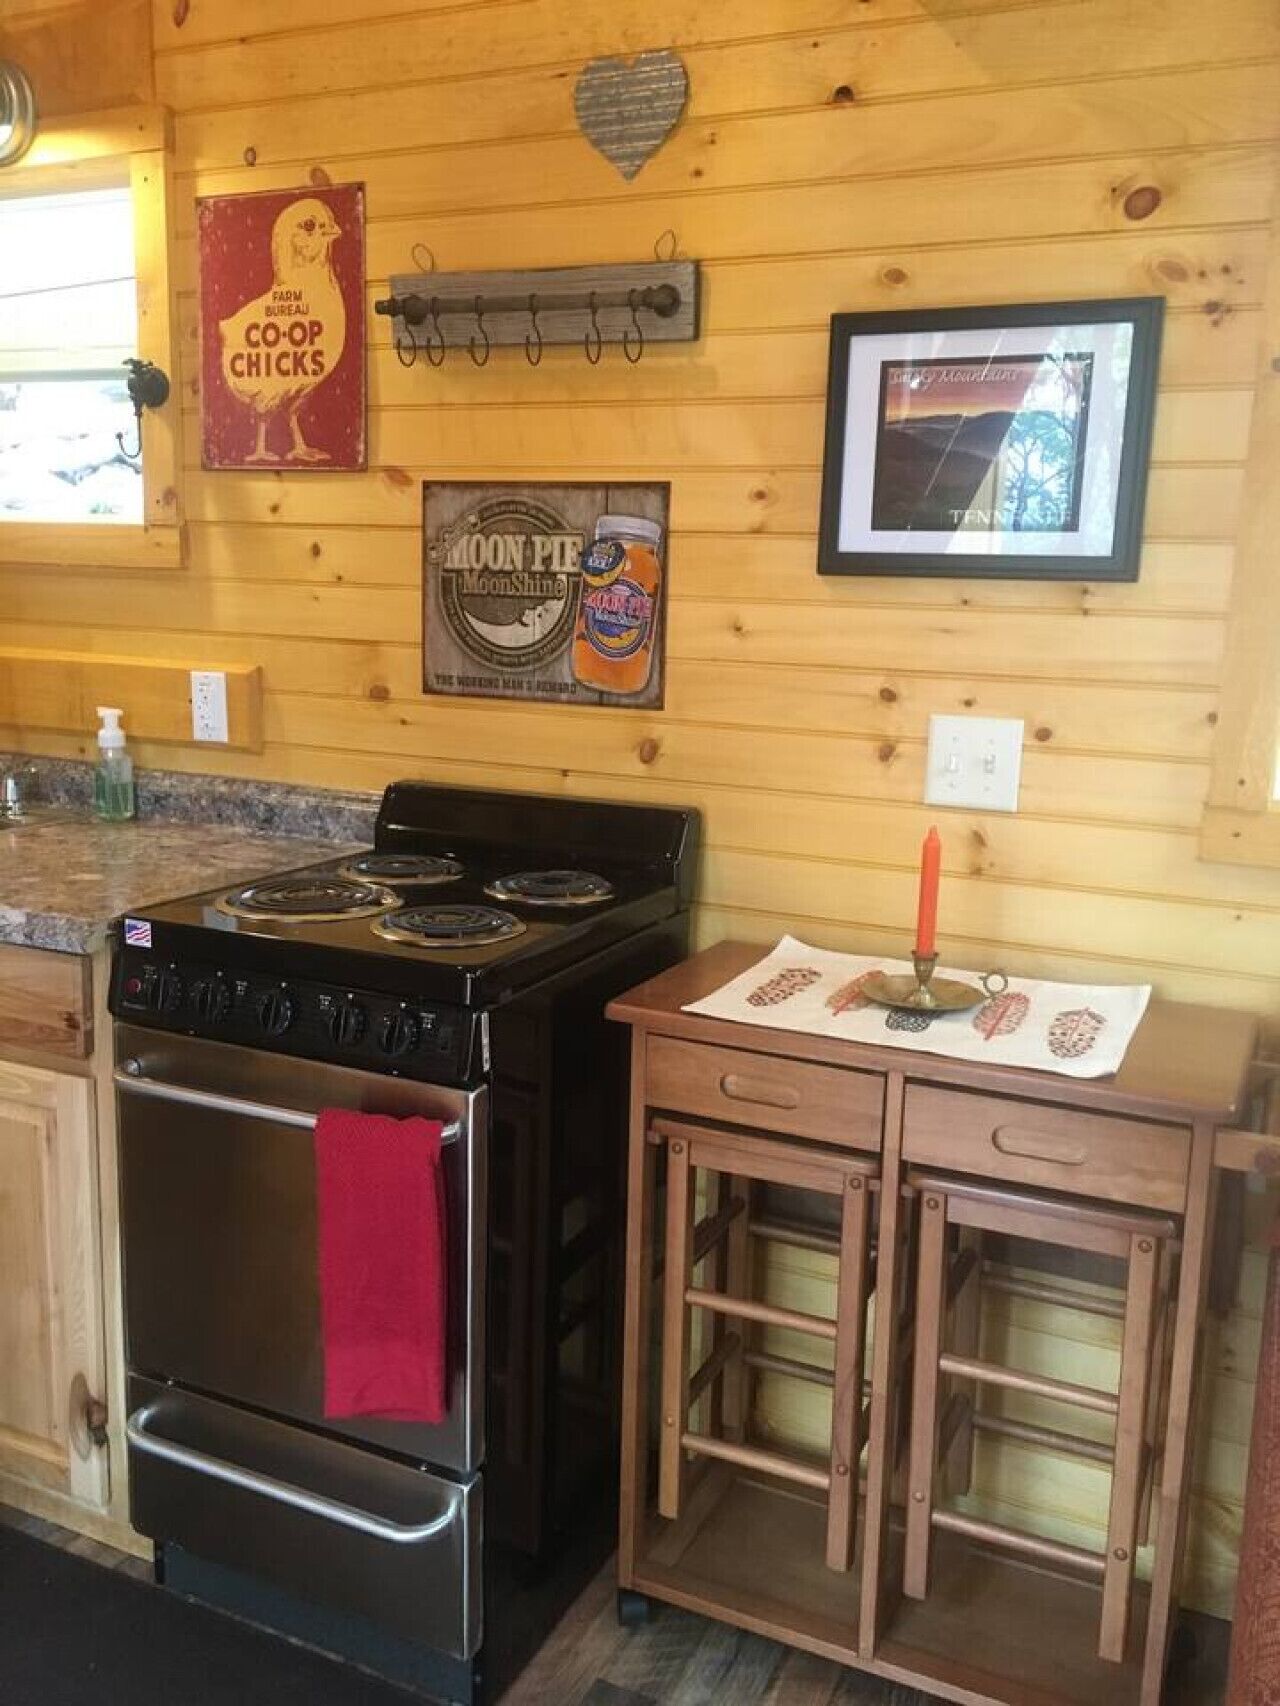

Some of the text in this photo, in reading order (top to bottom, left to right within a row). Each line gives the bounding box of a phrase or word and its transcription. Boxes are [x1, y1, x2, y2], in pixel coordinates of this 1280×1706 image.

[272, 290, 303, 302] FARM
[264, 303, 310, 317] BUREAU
[229, 350, 326, 378] CHICKS
[443, 534, 527, 571] MOON
[531, 535, 583, 572] PIE
[462, 571, 567, 597] MoonShine
